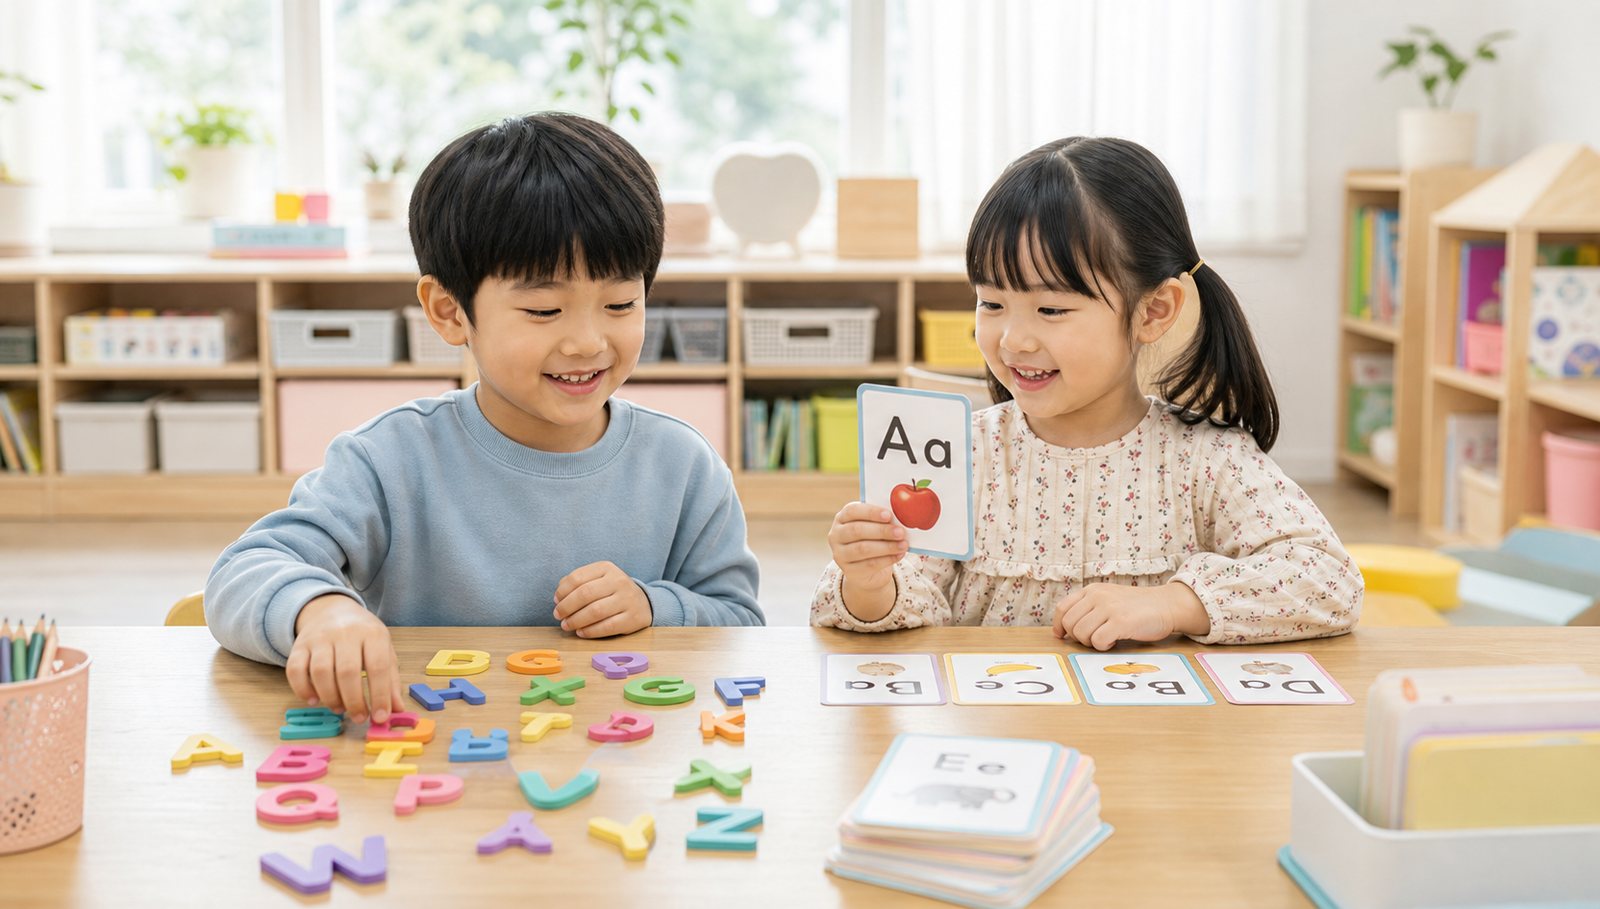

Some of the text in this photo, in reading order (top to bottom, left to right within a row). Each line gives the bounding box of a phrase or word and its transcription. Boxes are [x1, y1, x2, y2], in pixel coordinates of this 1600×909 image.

[877, 416, 951, 469] Aa
[409, 678, 486, 711] H
[624, 676, 695, 706] G
[714, 676, 766, 706] F
[700, 710, 746, 742] K
[171, 733, 244, 770] A
[256, 744, 332, 783] B
[933, 753, 1006, 775] Ee
[394, 774, 464, 816] P
[518, 770, 599, 810] V
[674, 758, 752, 797] X
[256, 782, 339, 824] Q
[476, 812, 553, 855] A
[588, 814, 656, 861] Y
[686, 806, 763, 852] Z
[260, 835, 387, 895] W
